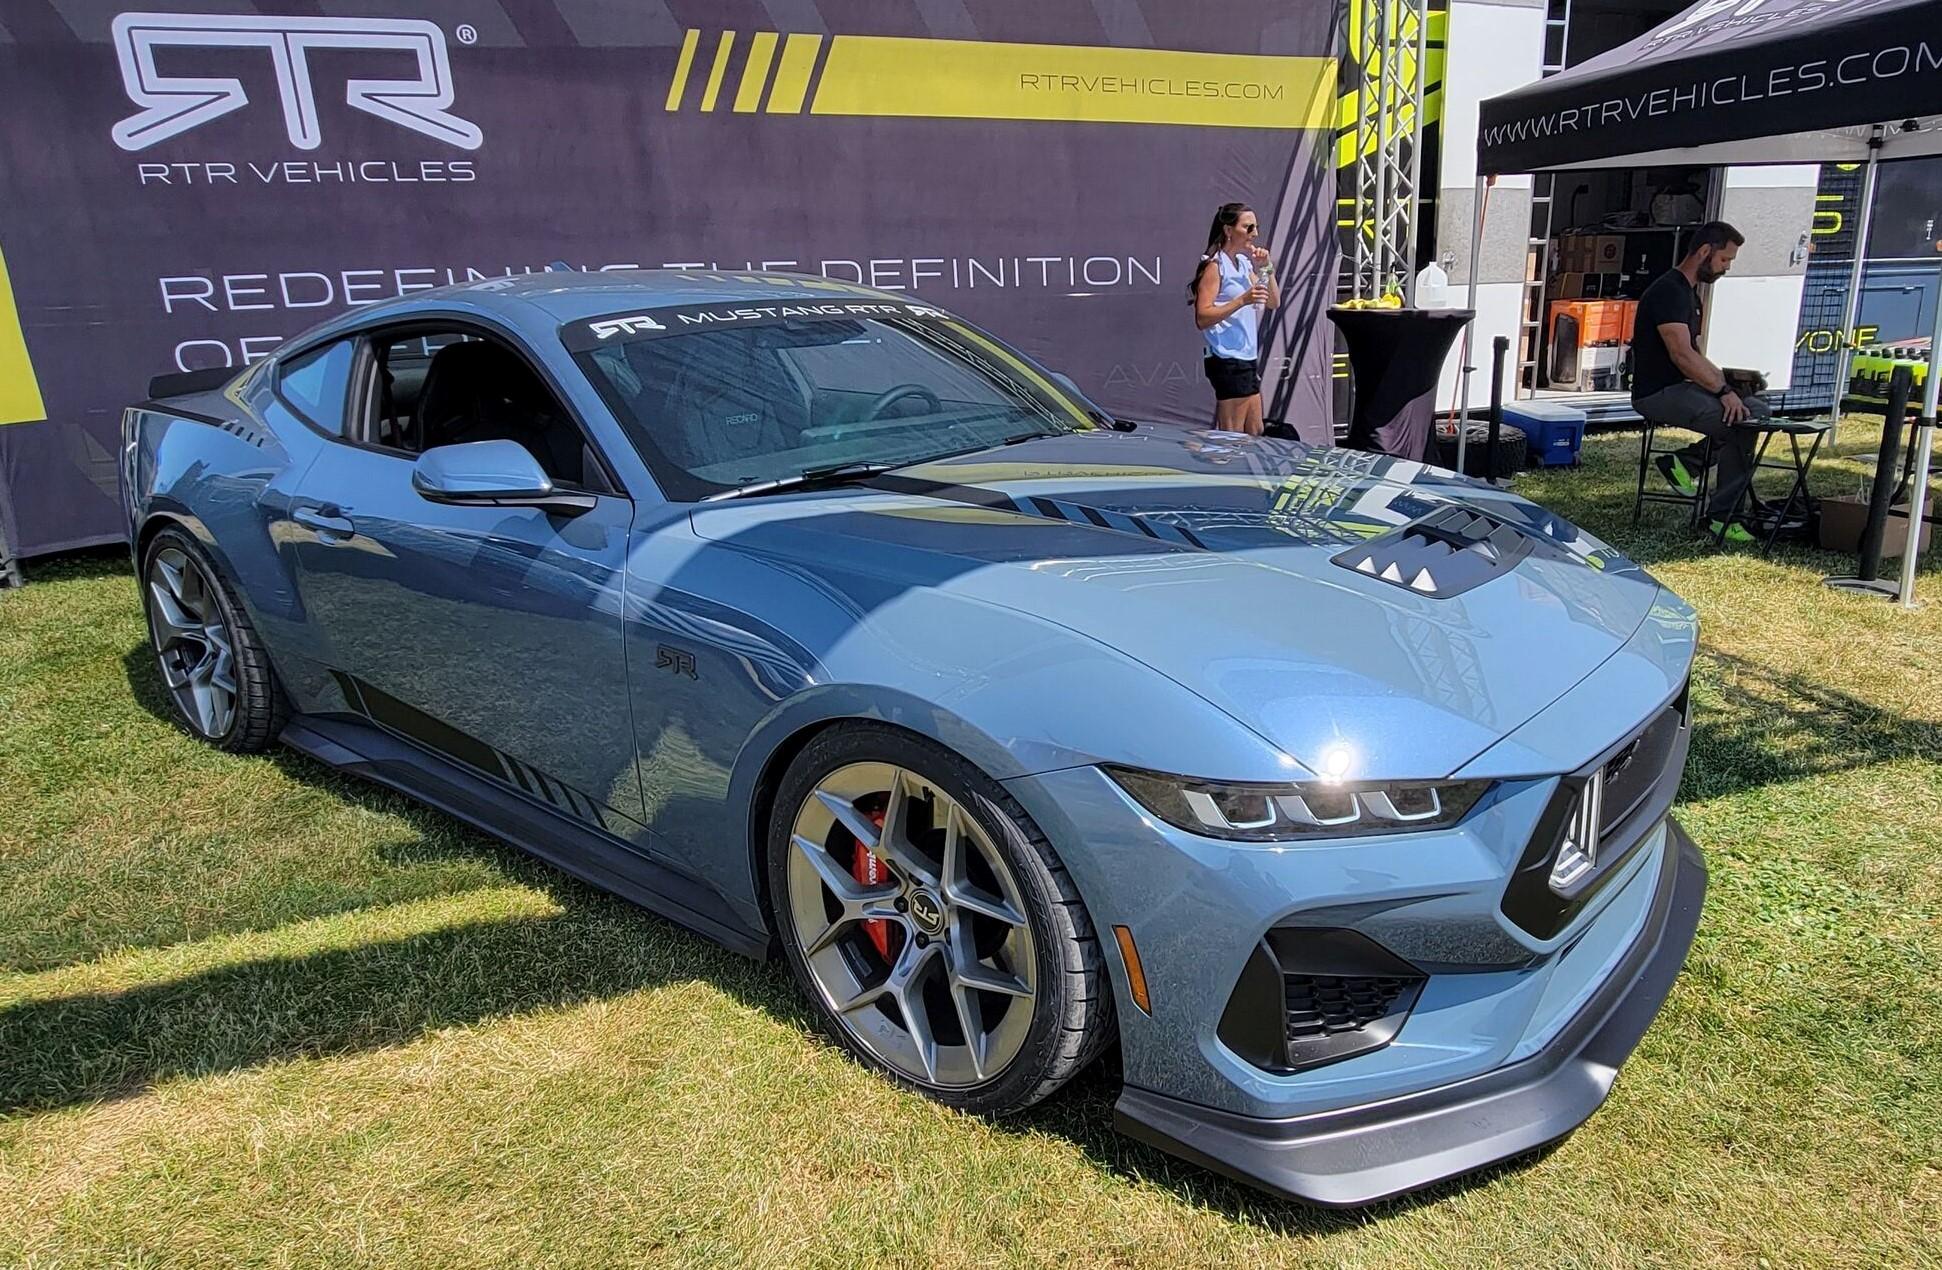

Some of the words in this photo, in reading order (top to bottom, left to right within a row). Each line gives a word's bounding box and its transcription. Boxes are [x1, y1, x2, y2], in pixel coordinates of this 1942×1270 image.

[1020, 73, 1284, 100] RTRVEHICLES.COM
[139, 162, 237, 185] RTR
[249, 161, 476, 184] VEHICLES
[821, 256, 1161, 290] DEFINITION
[677, 304, 844, 325] MUSTANG
[845, 304, 902, 314] RTR
